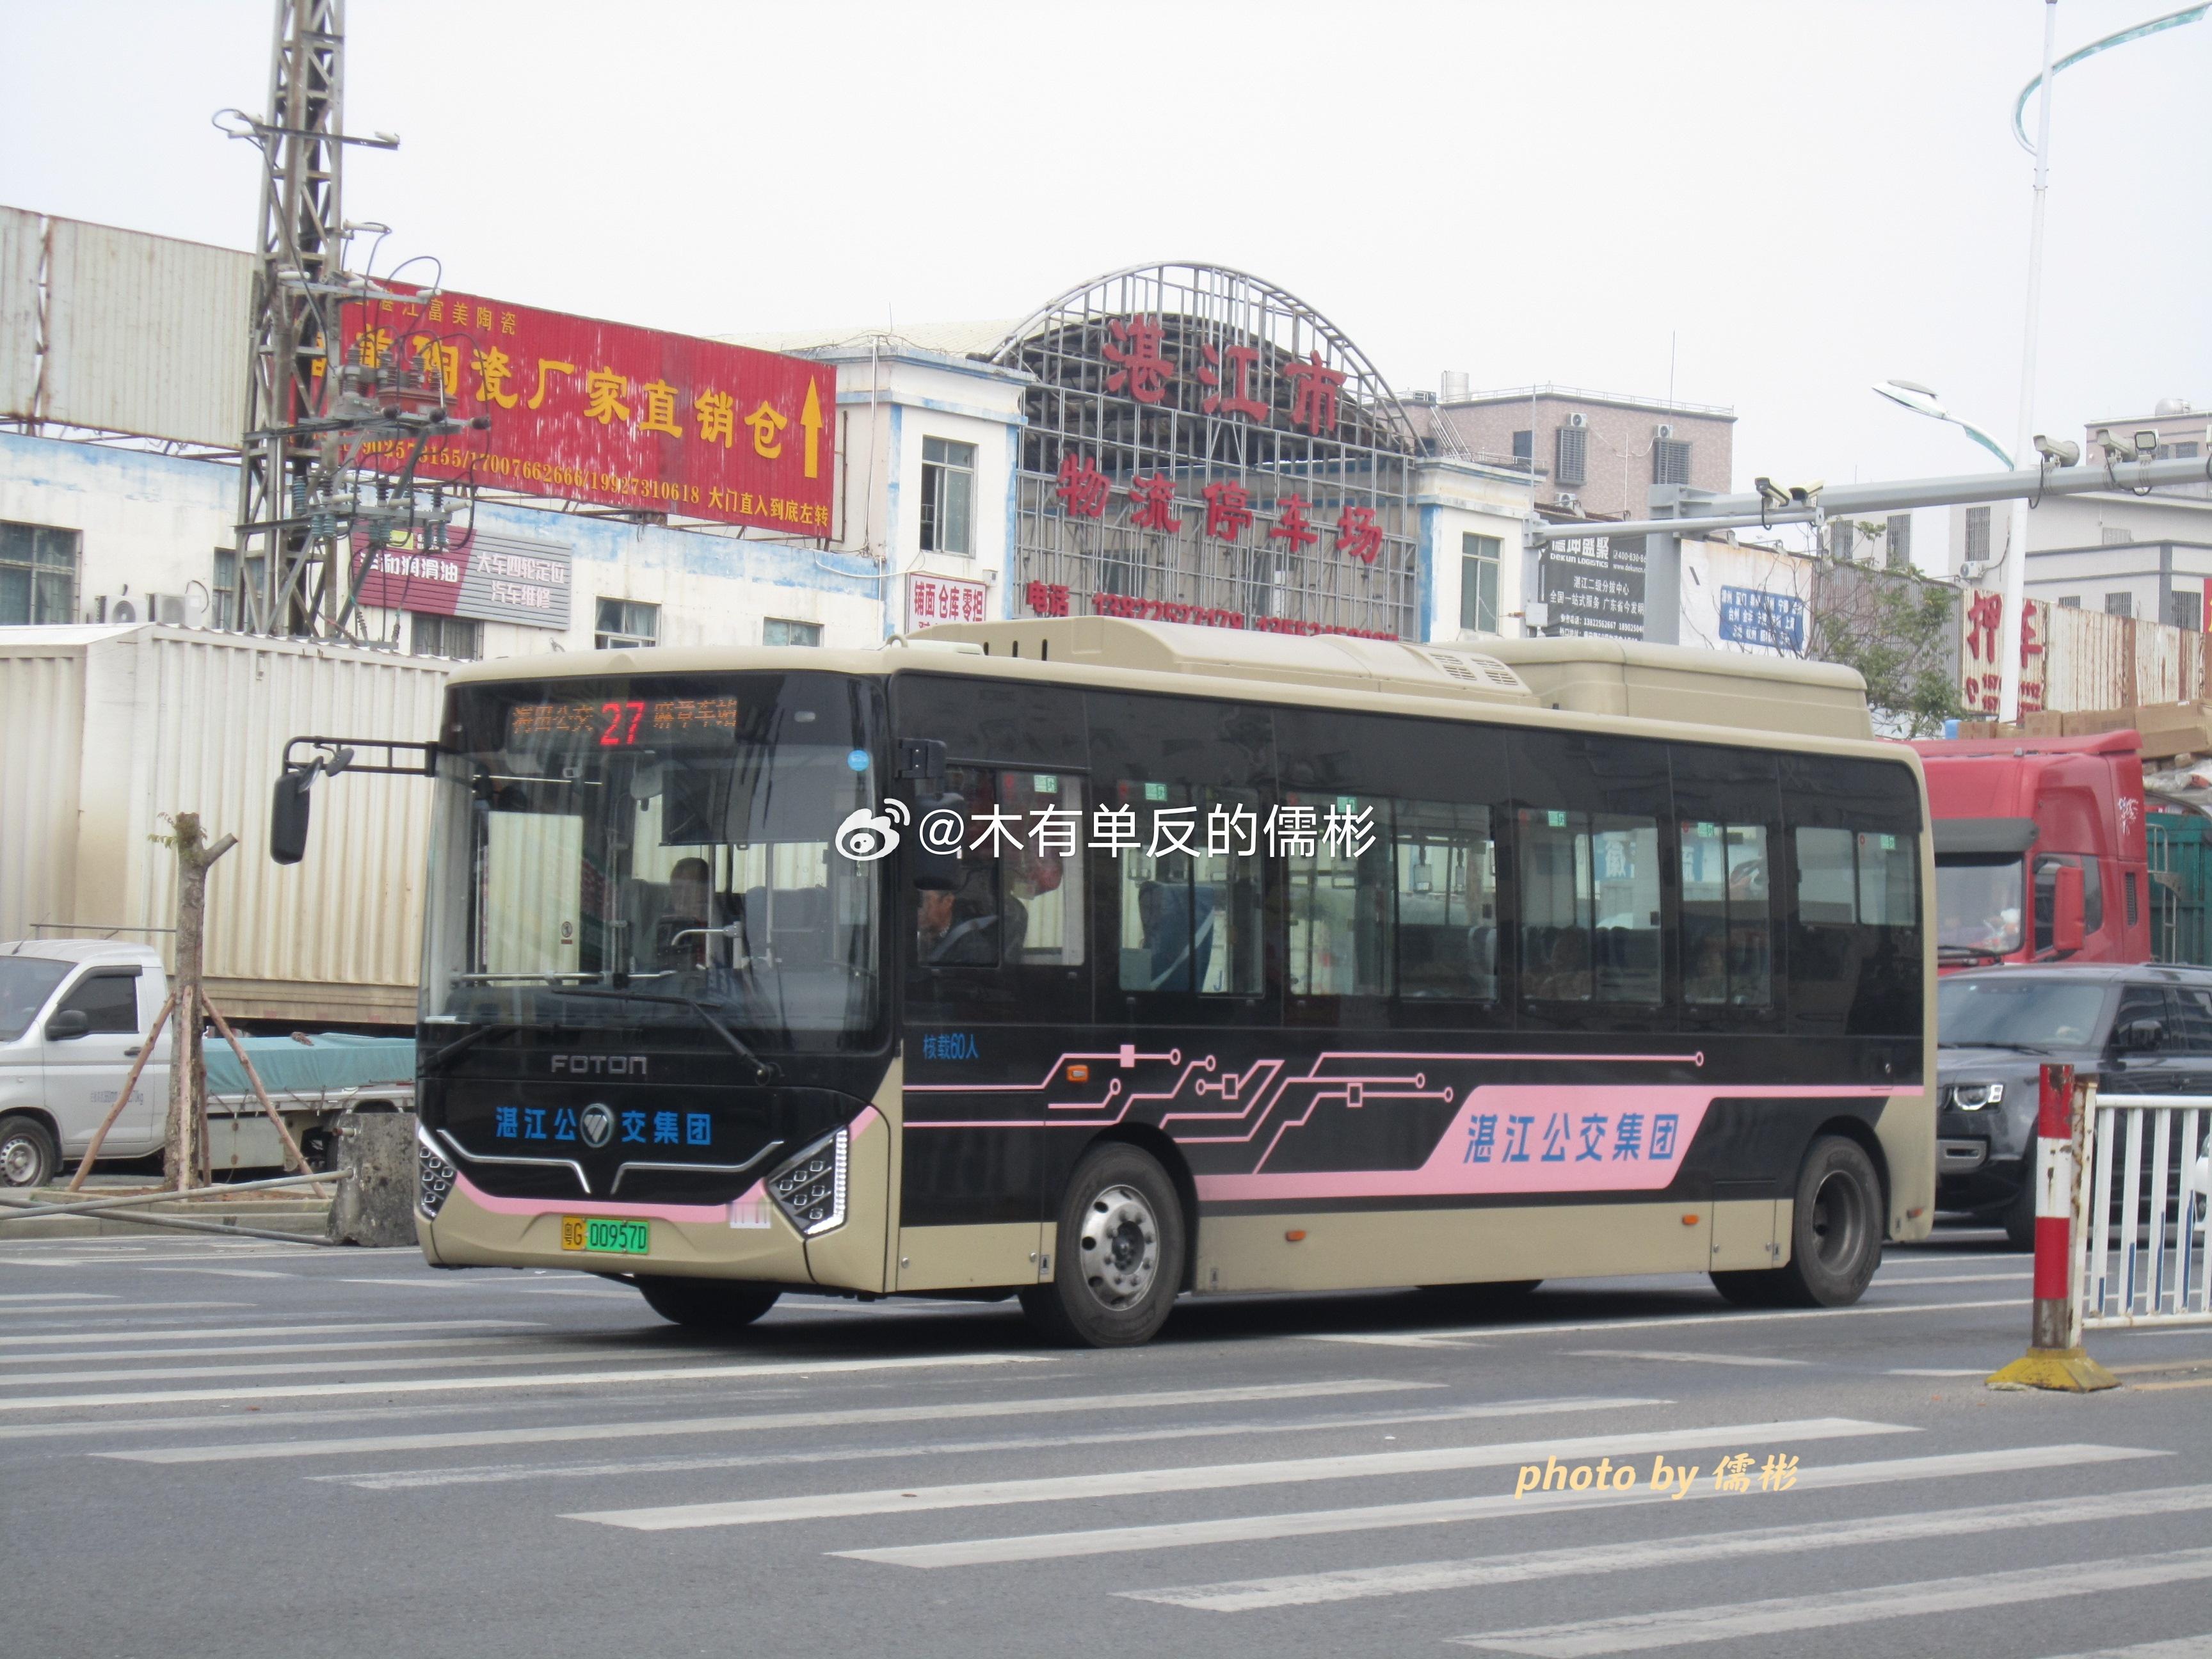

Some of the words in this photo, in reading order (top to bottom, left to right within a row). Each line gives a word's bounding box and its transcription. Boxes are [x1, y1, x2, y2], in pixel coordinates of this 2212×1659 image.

[1102, 314, 1347, 437] 湛江市
[708, 486, 829, 527] 大门直入到底左转
[1057, 454, 1383, 564] 物流停车场
[477, 551, 566, 584] 大车四轮定位
[1578, 557, 1608, 568] LOGISTICS
[491, 580, 551, 608] 汽车维修
[939, 584, 959, 620] 仓库
[1027, 580, 1070, 617] 电话
[1550, 589, 1599, 609] 全国一站式服务
[600, 701, 645, 745] 27
[551, 1055, 647, 1075] FOTON
[1463, 1112, 1679, 1164] 湛江公交集团
